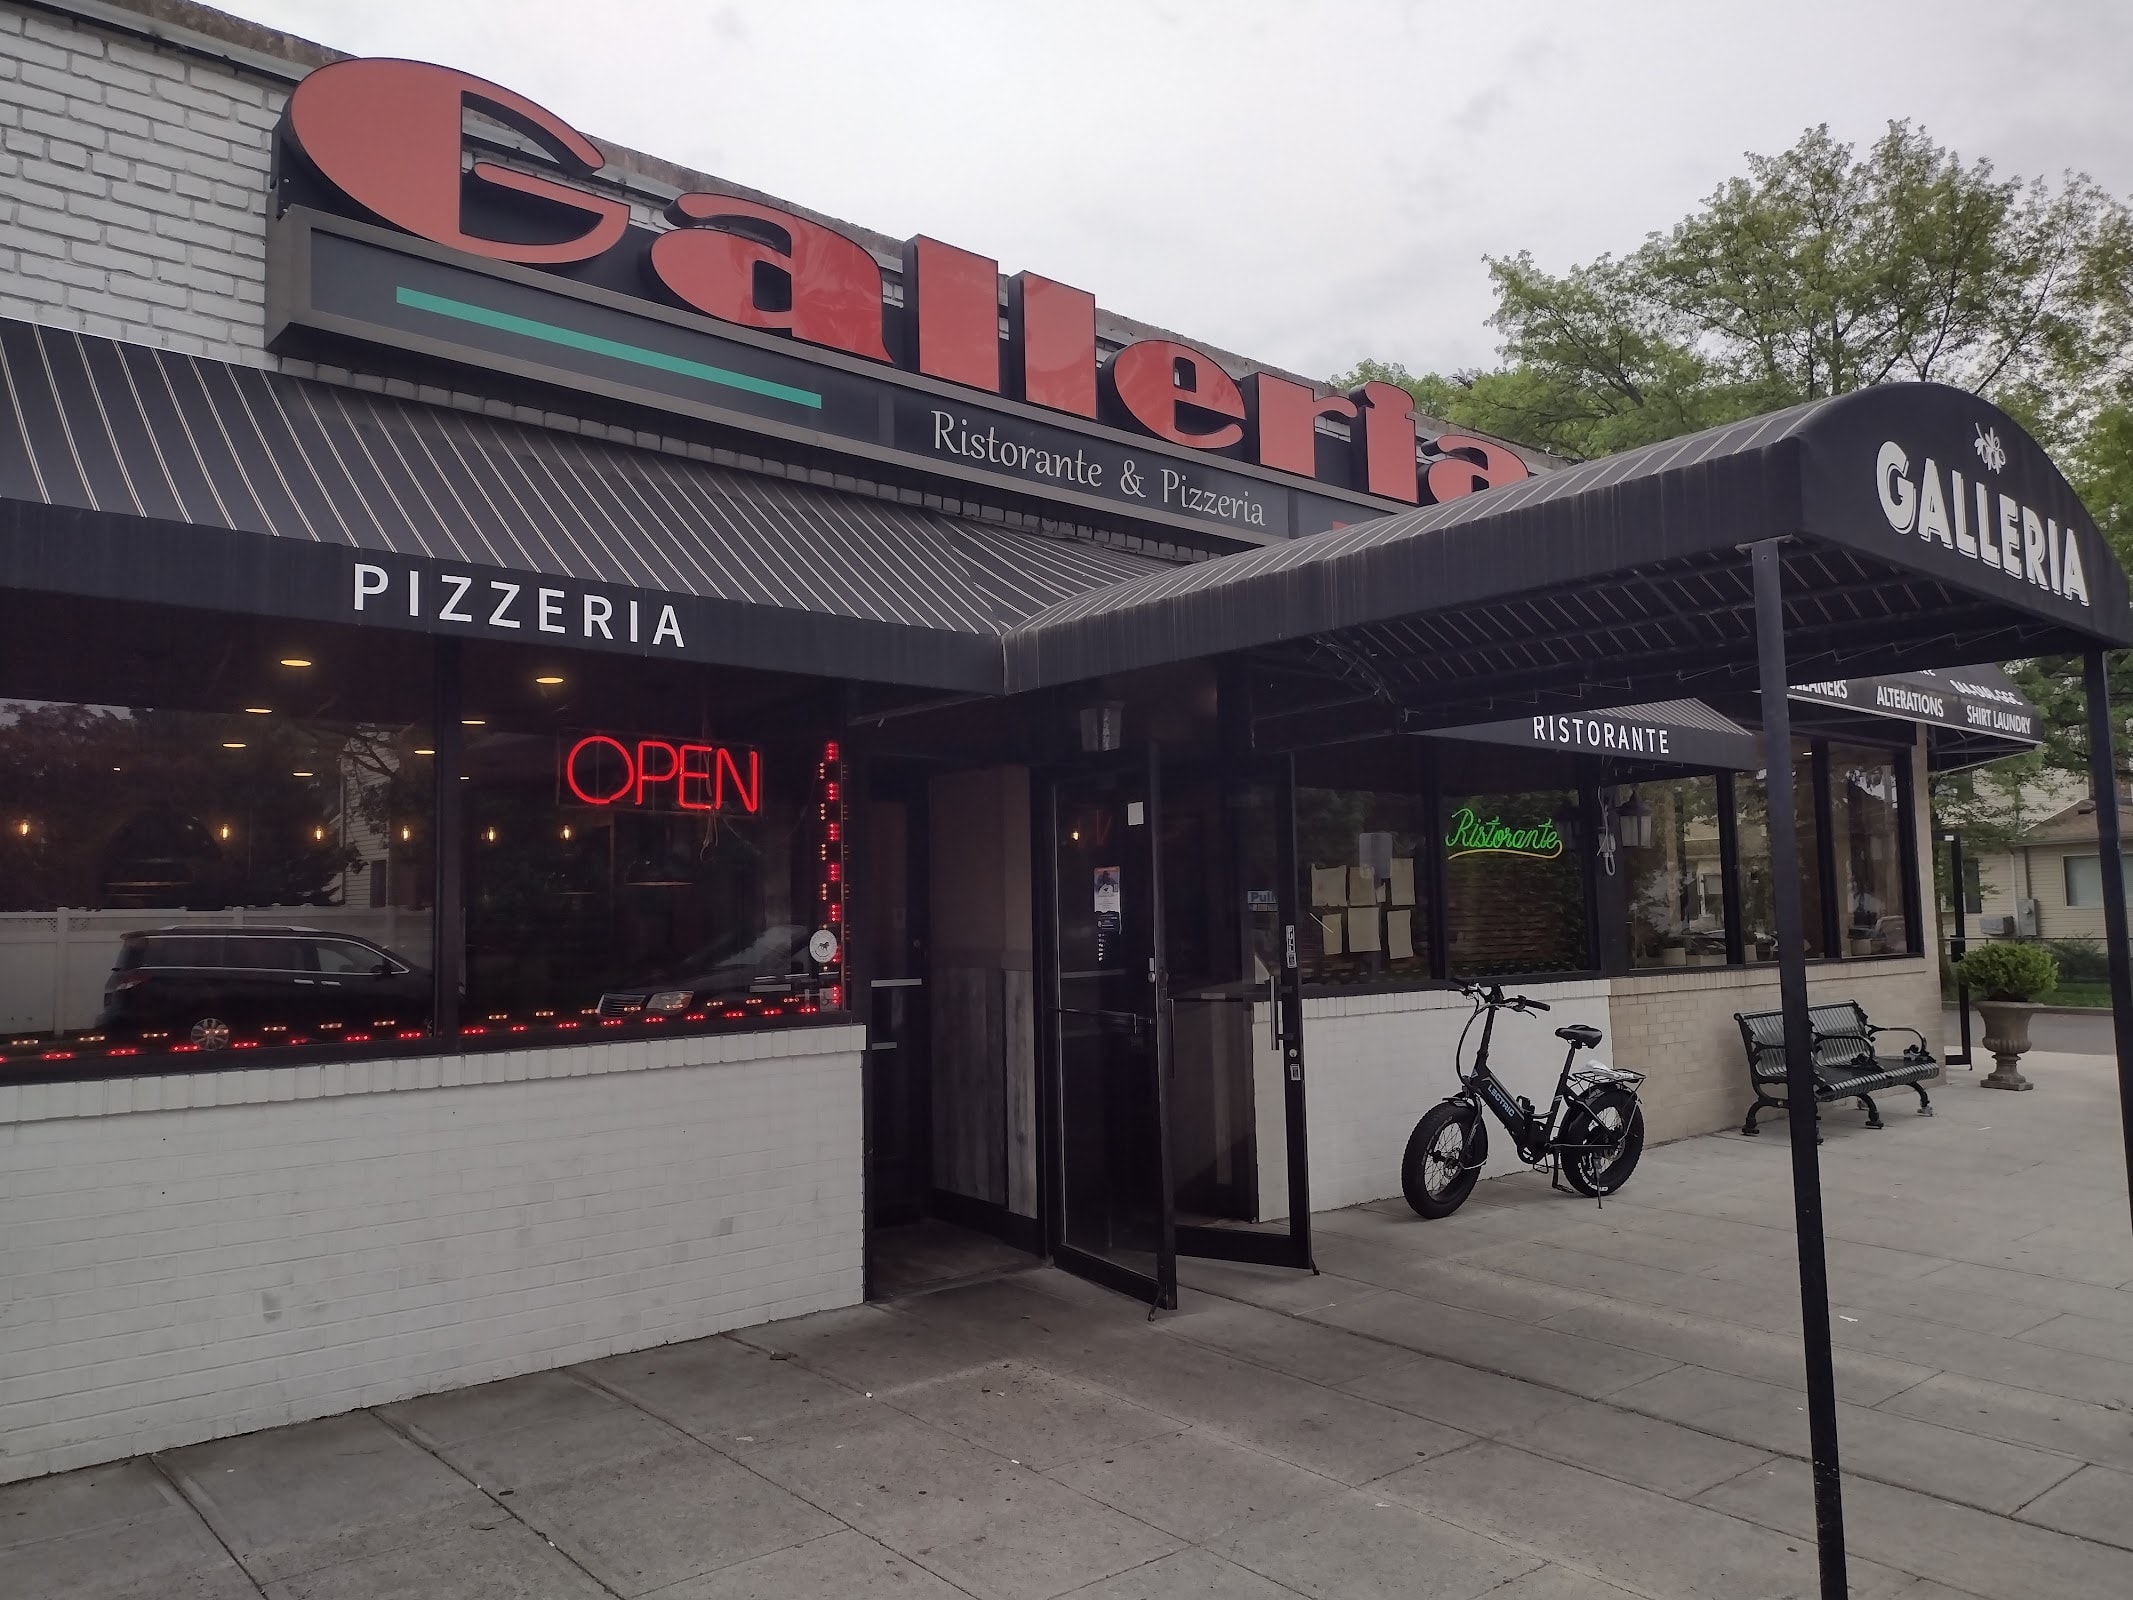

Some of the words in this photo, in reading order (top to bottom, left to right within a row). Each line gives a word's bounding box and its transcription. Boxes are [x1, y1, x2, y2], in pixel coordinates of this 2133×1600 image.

[288, 56, 1529, 504] Galleria
[931, 410, 1102, 487] Ristorante
[1120, 459, 1147, 498] &
[1160, 468, 1266, 527] Pizzeria
[1876, 440, 2090, 606] GALLERIA
[353, 563, 685, 648] PIZZERIA
[1533, 715, 1670, 754] RISTORANTE
[1876, 686, 1944, 718] ALTERATIONS
[1966, 705, 1992, 727] SHIRT
[1993, 710, 2032, 735] LAUNDRY
[567, 736, 758, 812] OPEN
[1445, 808, 1562, 851] Ristorante
